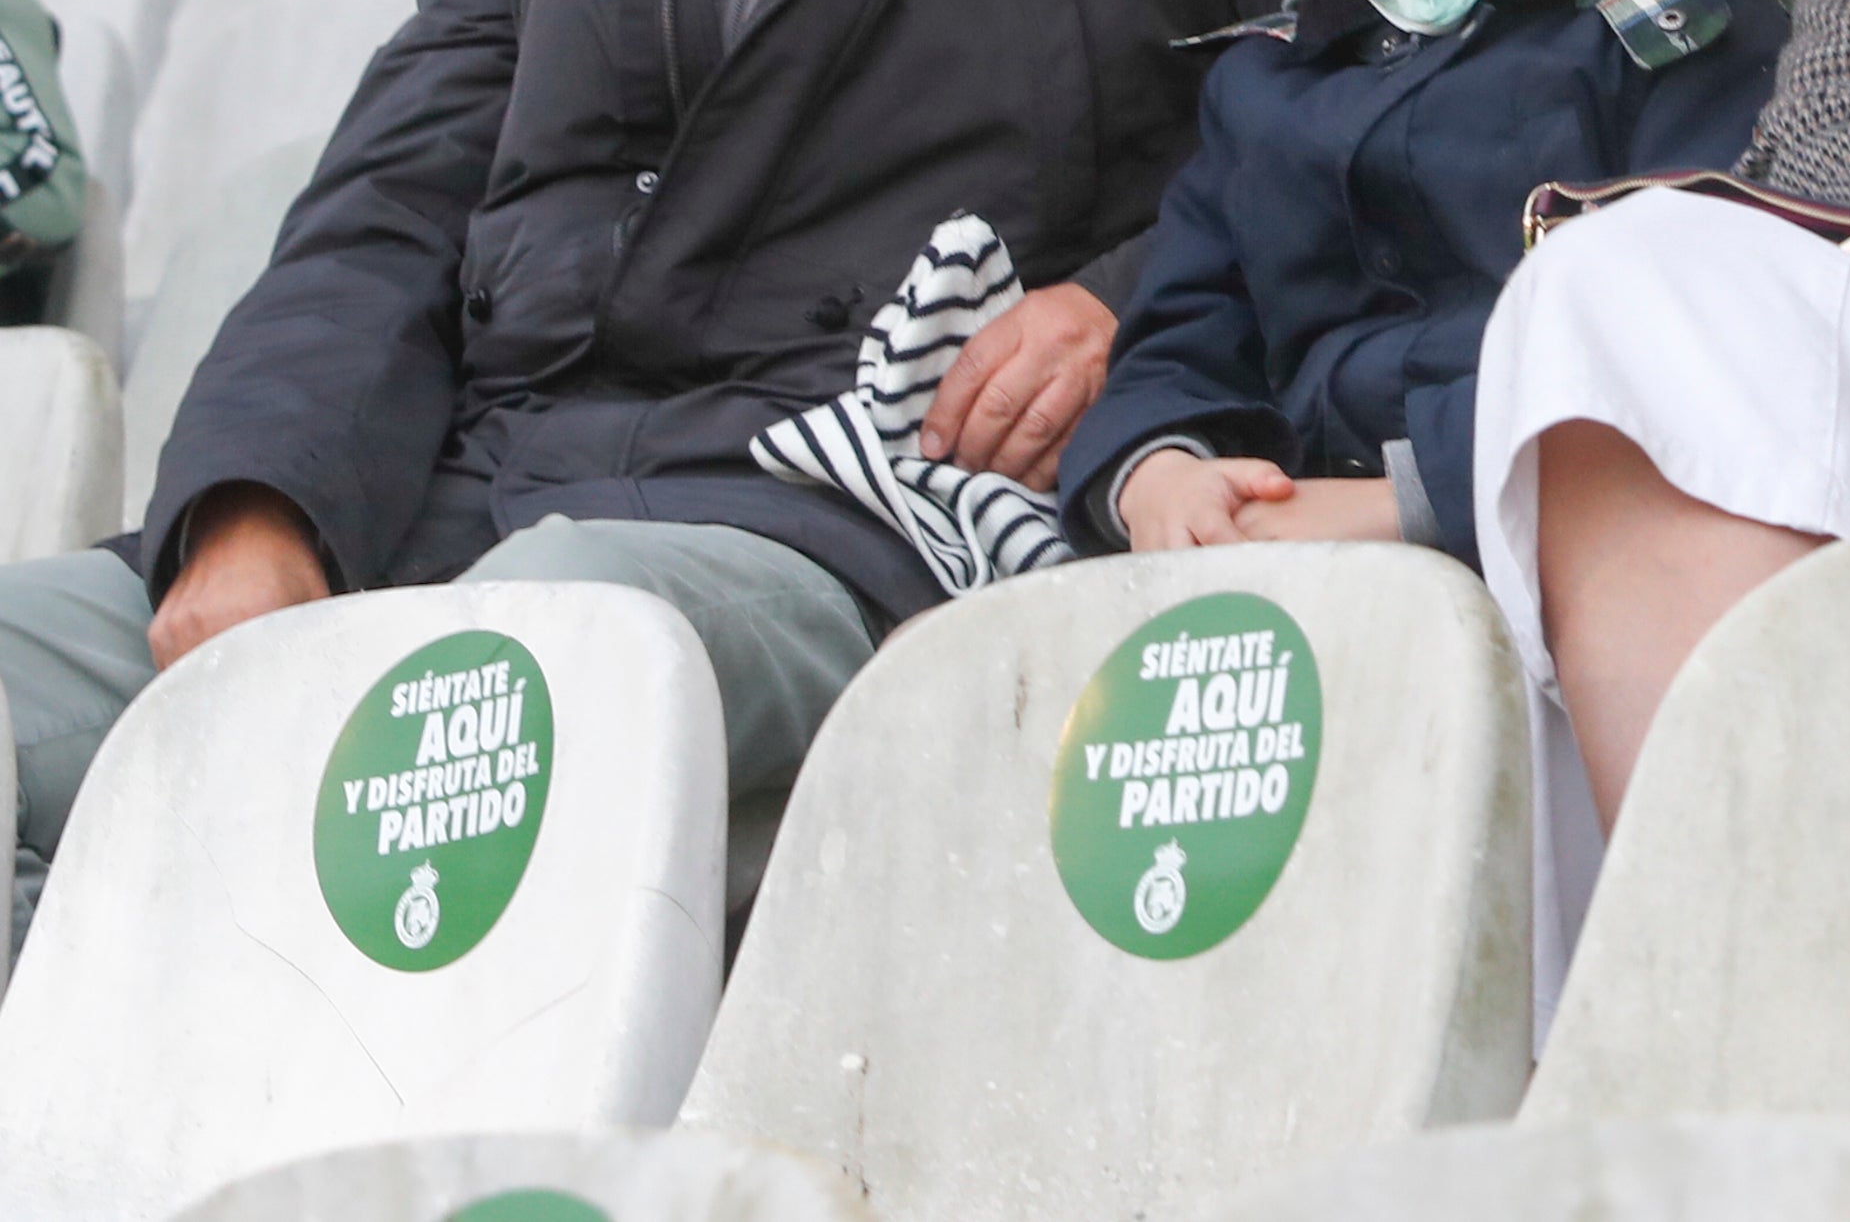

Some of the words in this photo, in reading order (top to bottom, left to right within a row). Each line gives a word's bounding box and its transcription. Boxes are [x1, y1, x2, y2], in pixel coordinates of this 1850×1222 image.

[390, 660, 510, 718] SIÉNTATE
[1139, 630, 1275, 681] SIÉNTATE
[415, 677, 527, 767] AQUÍ
[1165, 650, 1293, 737] AQUÍ
[343, 779, 364, 814] Y
[366, 754, 491, 812] DISFRUTA
[496, 741, 540, 785] DEL
[1085, 744, 1107, 781] Y
[1109, 729, 1250, 780] DISFRUTA
[1254, 722, 1305, 766] DEL
[378, 780, 527, 856] PARTIDO
[1119, 763, 1289, 828] PARTIDO
